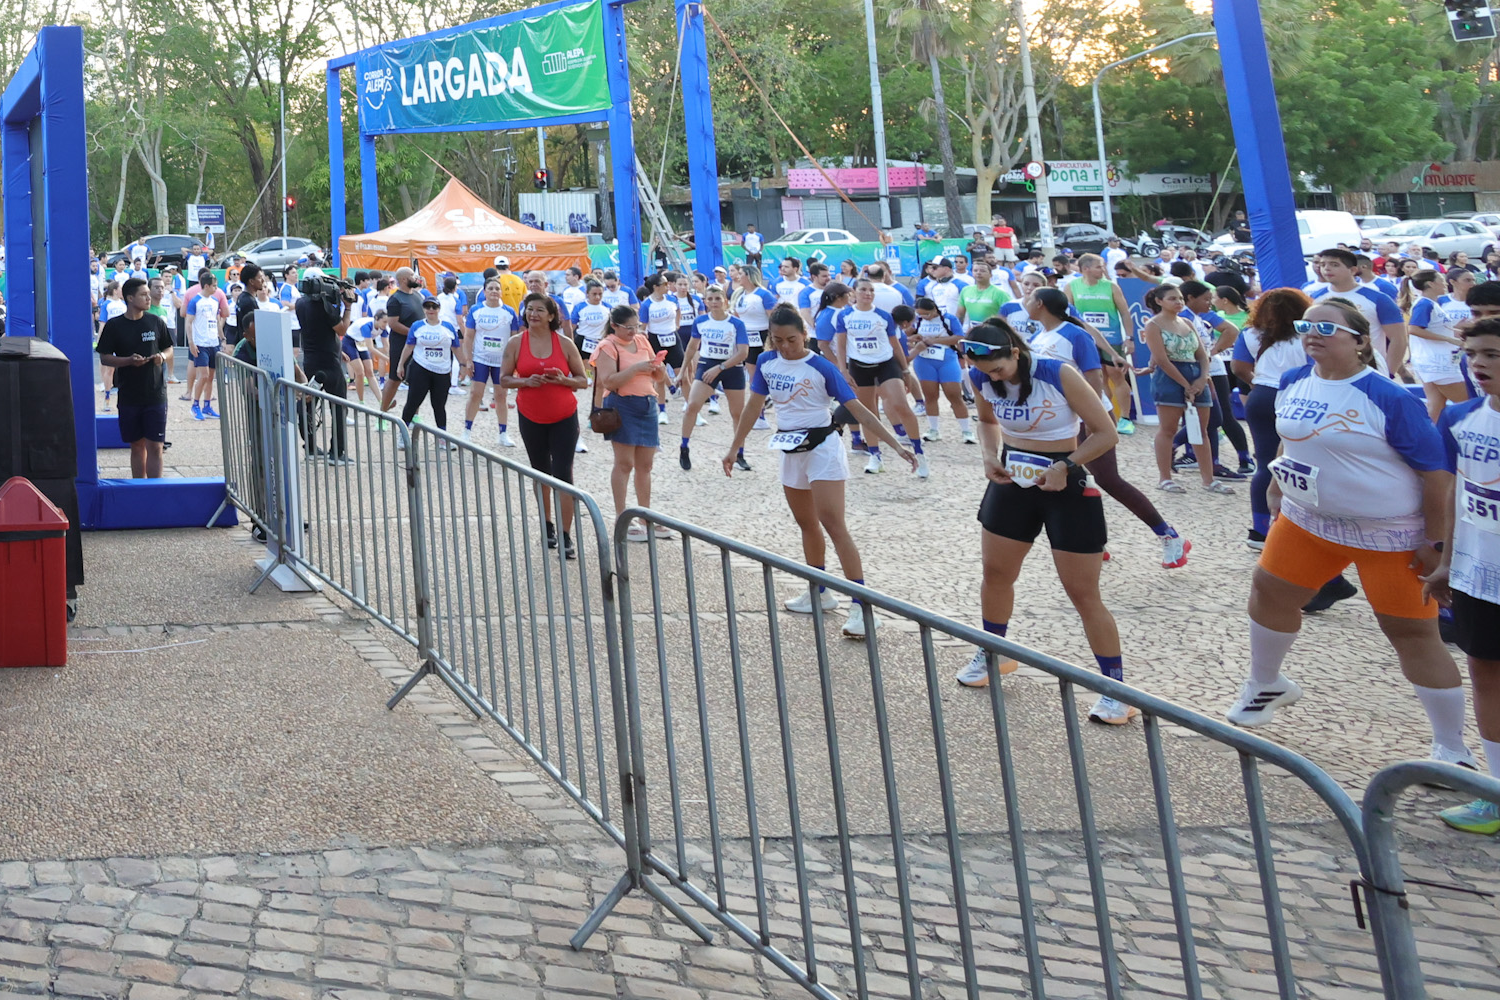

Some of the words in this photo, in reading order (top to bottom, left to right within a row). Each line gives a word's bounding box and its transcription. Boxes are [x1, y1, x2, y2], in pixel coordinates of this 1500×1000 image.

[566, 47, 585, 59] ALEPI
[363, 68, 384, 81] CORRIDA
[400, 46, 533, 106] LARGADA
[365, 78, 384, 94] ALEPI
[1161, 176, 1212, 184] Carlos
[469, 243, 481, 252] 99
[708, 346, 729, 356] 5336
[856, 341, 878, 349] 5481
[425, 350, 443, 358] 5099
[1285, 397, 1329, 411] RRIDA
[772, 434, 802, 445] 5526
[1457, 430, 1500, 449] ORRID
[1459, 442, 1500, 467] LEP
[1272, 466, 1308, 491] 5713
